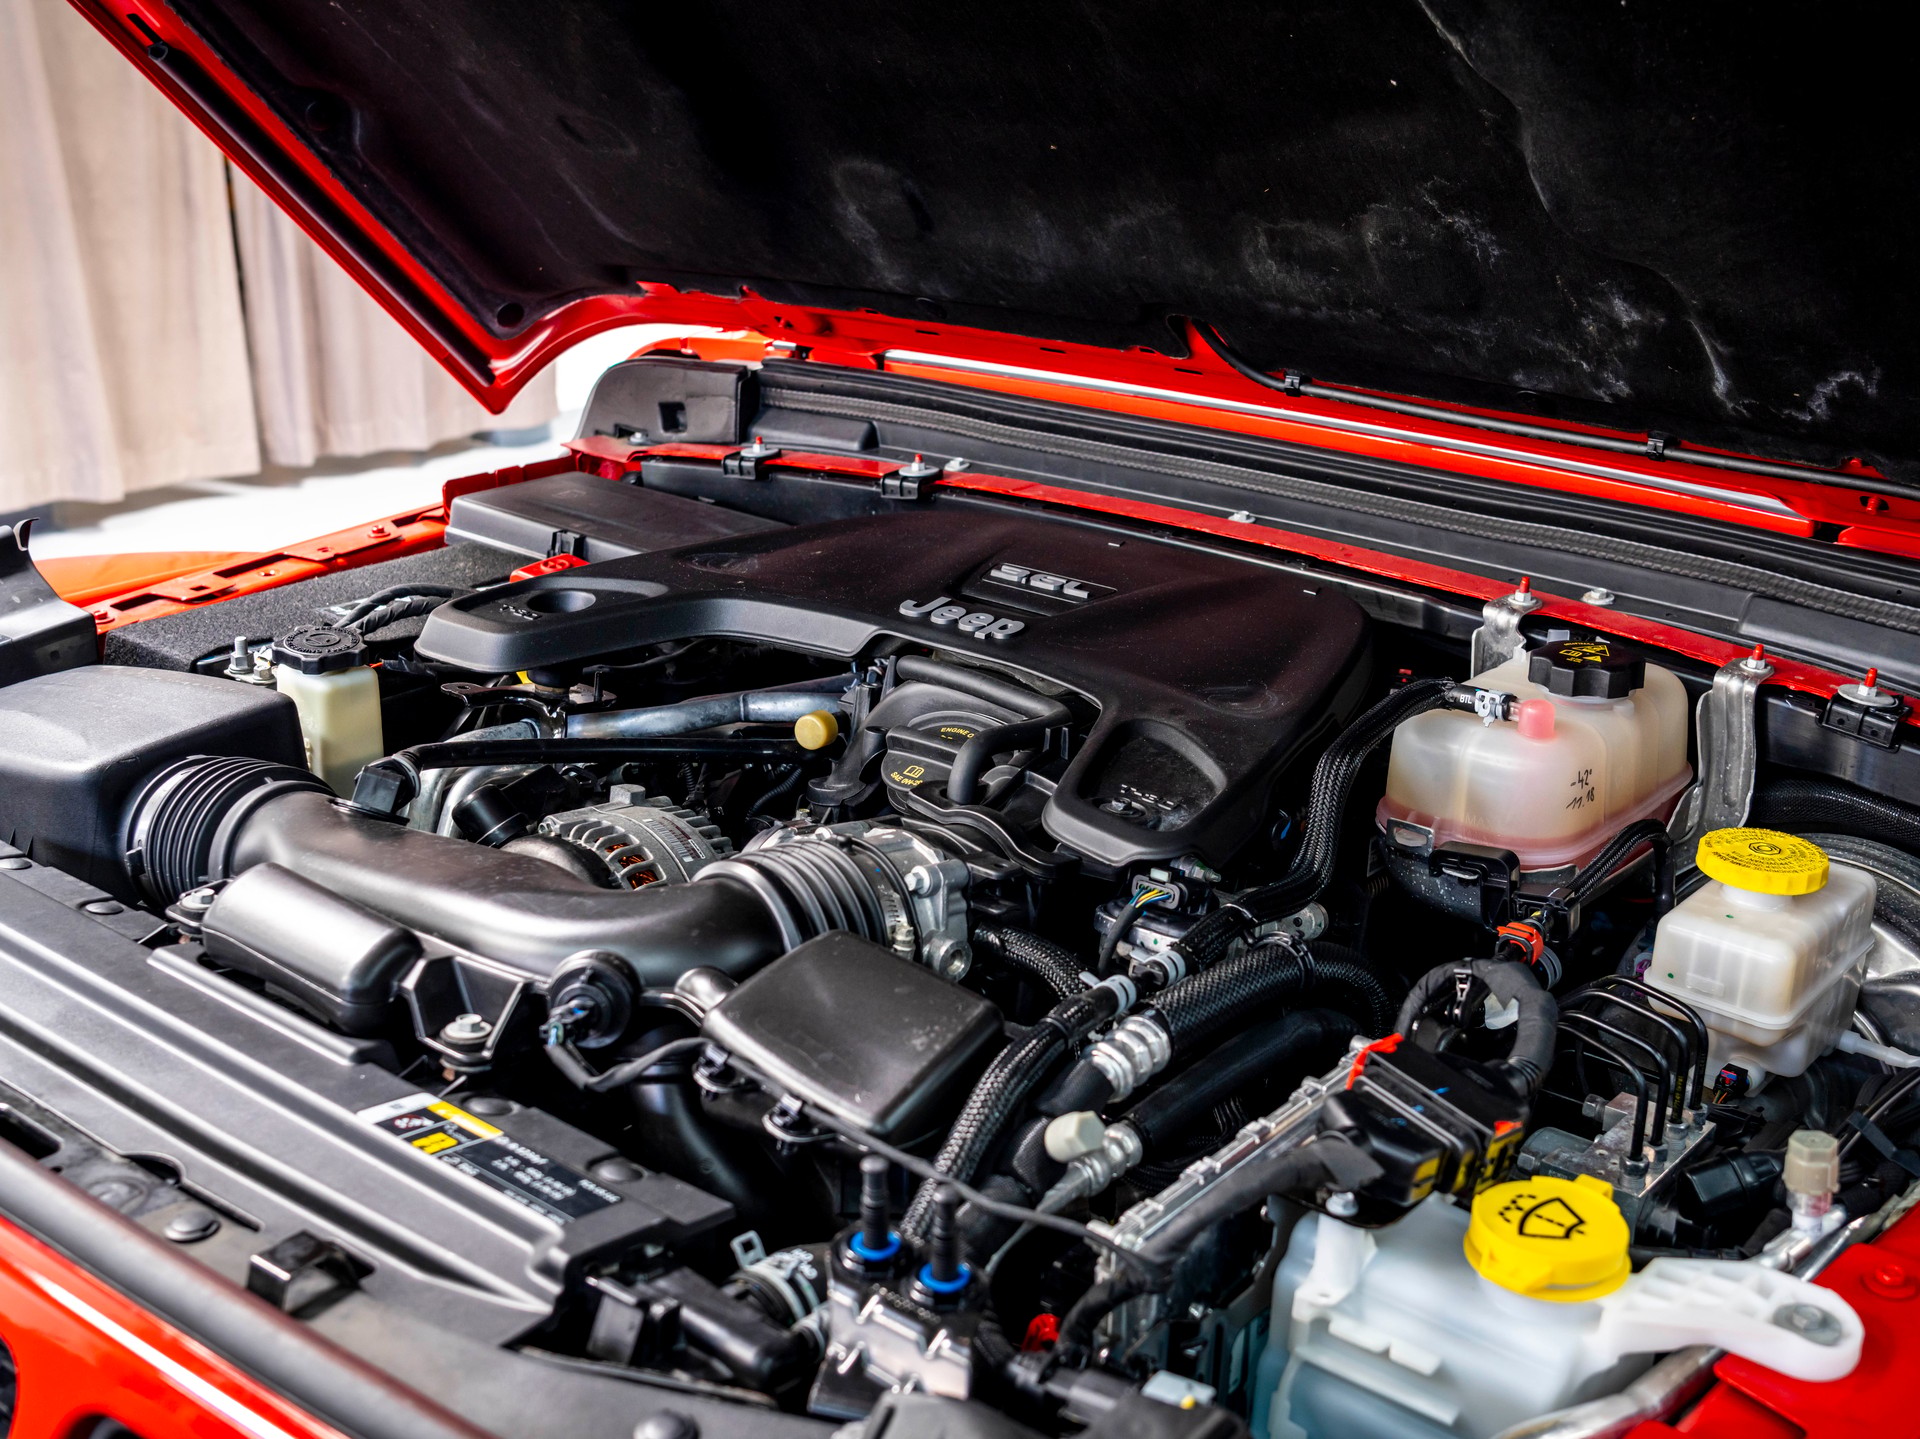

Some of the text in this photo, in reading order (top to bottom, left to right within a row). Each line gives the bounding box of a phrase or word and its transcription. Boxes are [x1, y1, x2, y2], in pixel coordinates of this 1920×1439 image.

[990, 563, 1090, 600] 3.6L
[898, 595, 1026, 641] Jeep
[1459, 693, 1474, 705] BTL
[940, 727, 970, 736] ENGINE
[890, 771, 904, 782] SAE
